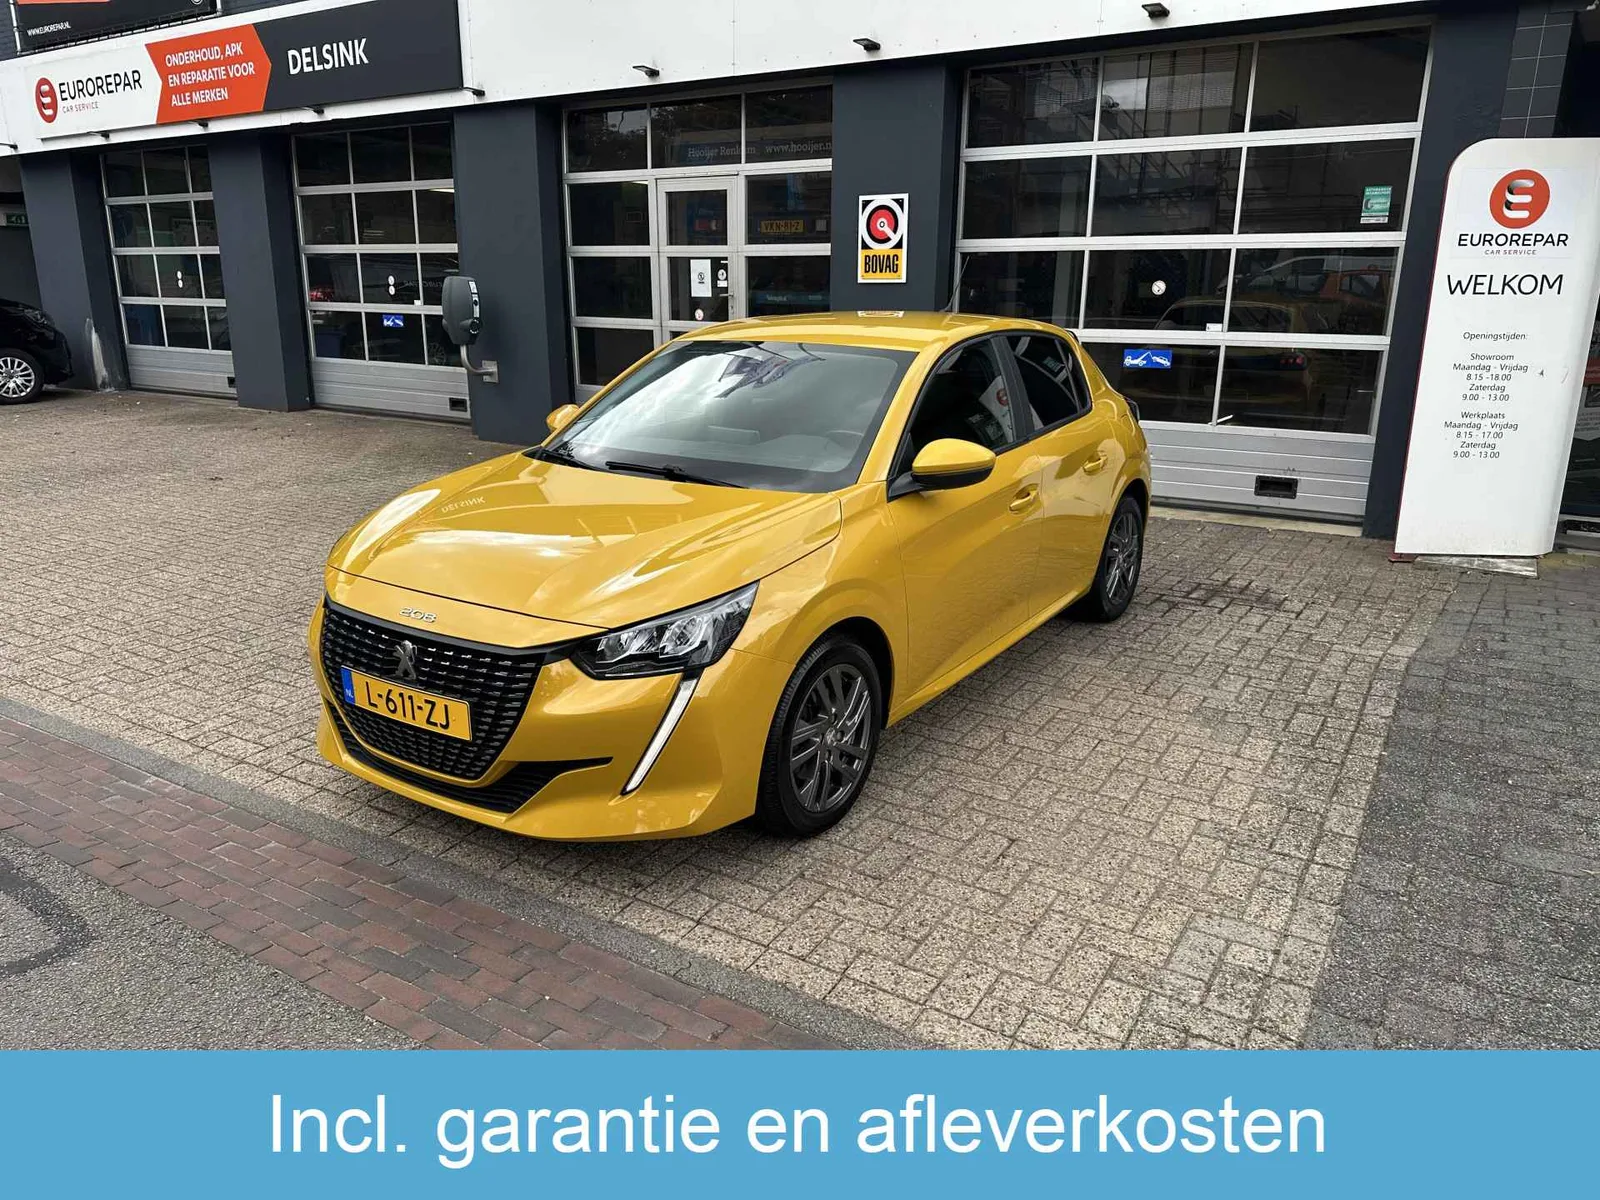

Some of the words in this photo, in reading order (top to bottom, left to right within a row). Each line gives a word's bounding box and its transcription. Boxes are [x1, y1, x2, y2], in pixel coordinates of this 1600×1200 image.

[165, 46, 224, 67] ONDERHOUD,
[225, 42, 244, 57] APK
[287, 38, 369, 75] DELSINK
[168, 74, 180, 87] EN
[180, 66, 227, 85] REPARATIE
[227, 61, 255, 78] VOOR
[58, 70, 142, 101] EUROREPAR
[171, 92, 192, 107] ALLE
[192, 87, 229, 104] MERKEN
[62, 105, 74, 114] CAR
[74, 101, 99, 112] SERVICE
[1457, 233, 1569, 247] EUROREPAR
[864, 254, 899, 274] BOVAG
[1447, 274, 1563, 295] WELKOM
[1463, 331, 1528, 342] Openingstijden:
[1470, 352, 1514, 361] Showroom
[1452, 363, 1491, 373] Maandag
[1500, 364, 1529, 373] Vrijdag
[1466, 373, 1484, 381] 8.15
[1469, 383, 1506, 393] Zaterdag
[1488, 394, 1510, 402] 13.00
[1461, 411, 1505, 421] Werkplaats
[1444, 420, 1482, 431] Maandag
[1490, 421, 1519, 431] Vrijdag
[1456, 431, 1473, 439] 8.15
[1482, 432, 1504, 440] 17.00
[1460, 441, 1497, 451] Zaterdag
[1453, 451, 1470, 459] 9.00
[1479, 451, 1500, 459] 13.00
[399, 607, 437, 623] 208
[345, 688, 354, 698] NL
[365, 681, 450, 730] L-611-ZJ
